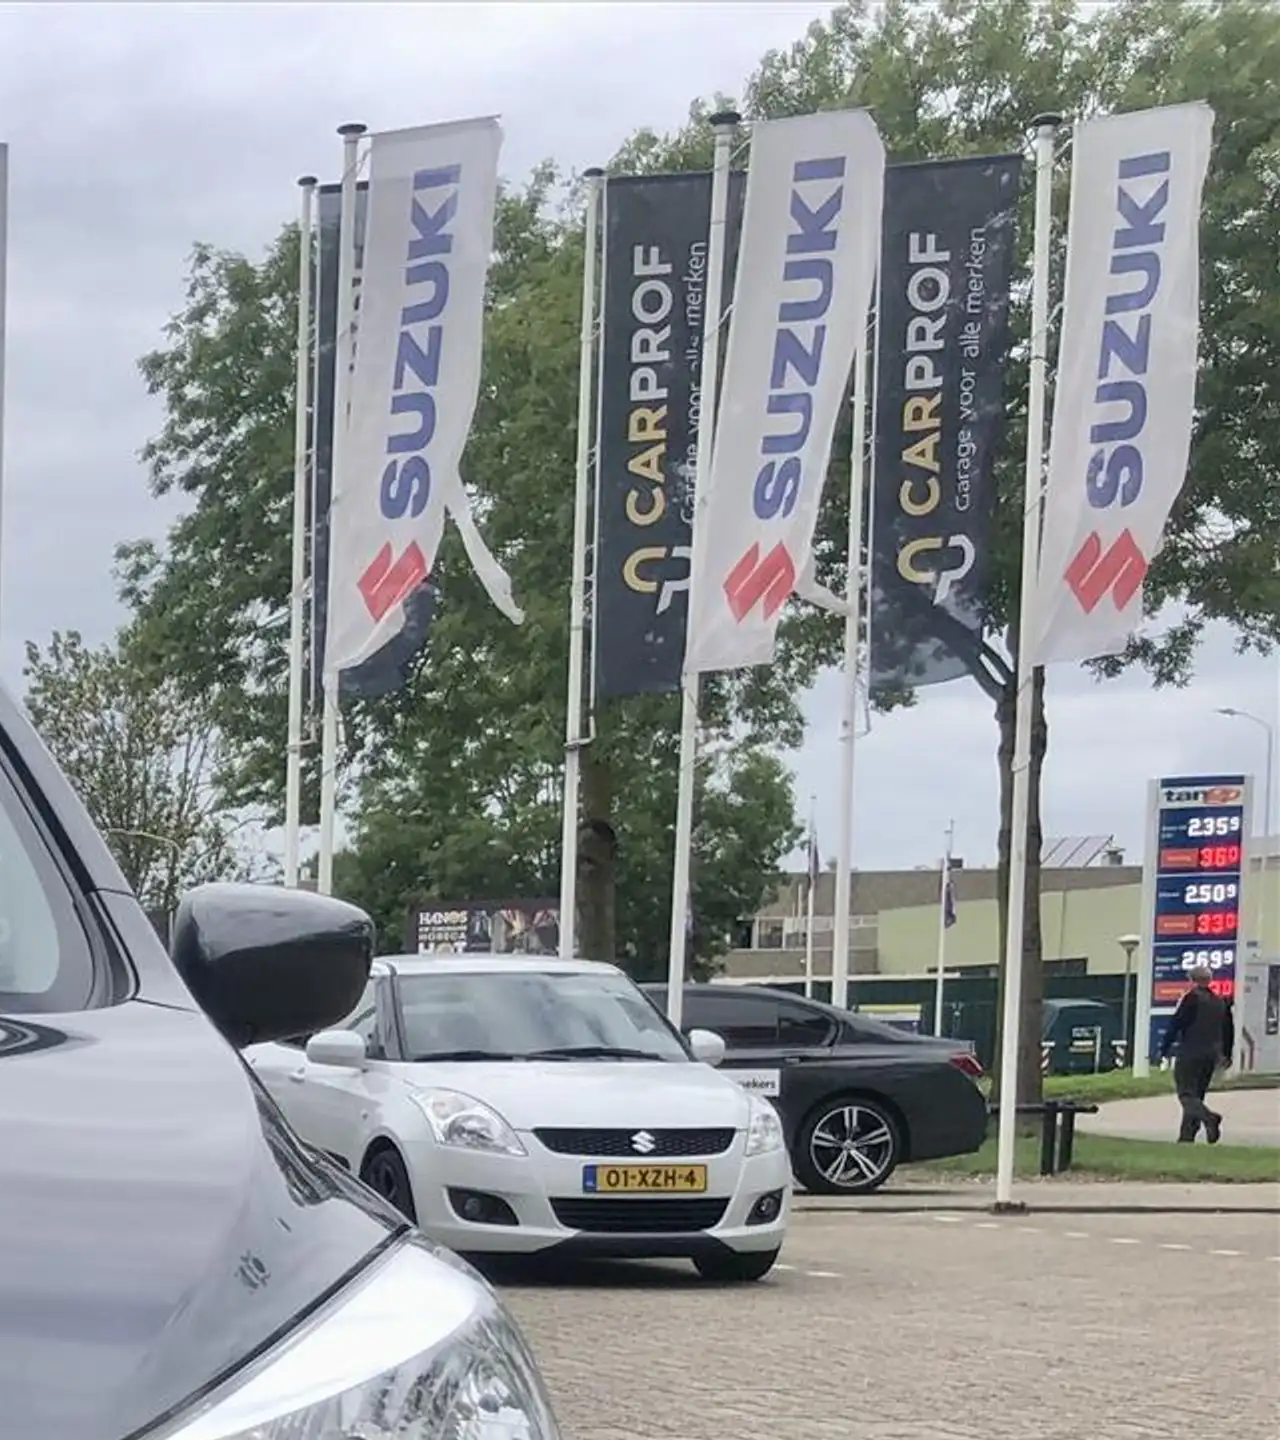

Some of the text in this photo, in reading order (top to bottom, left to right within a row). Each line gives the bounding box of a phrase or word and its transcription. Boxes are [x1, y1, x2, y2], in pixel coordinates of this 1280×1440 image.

[380, 163, 461, 520] SUZUKI
[625, 245, 673, 526] CARPROF
[682, 241, 708, 327] merken
[753, 156, 846, 520] SUZUKI
[899, 232, 950, 517] CARPROF
[955, 226, 987, 512] Garage voor alle merken
[1086, 151, 1171, 510] SUZUKI
[606, 1169, 697, 1188] 01-XZH-4
